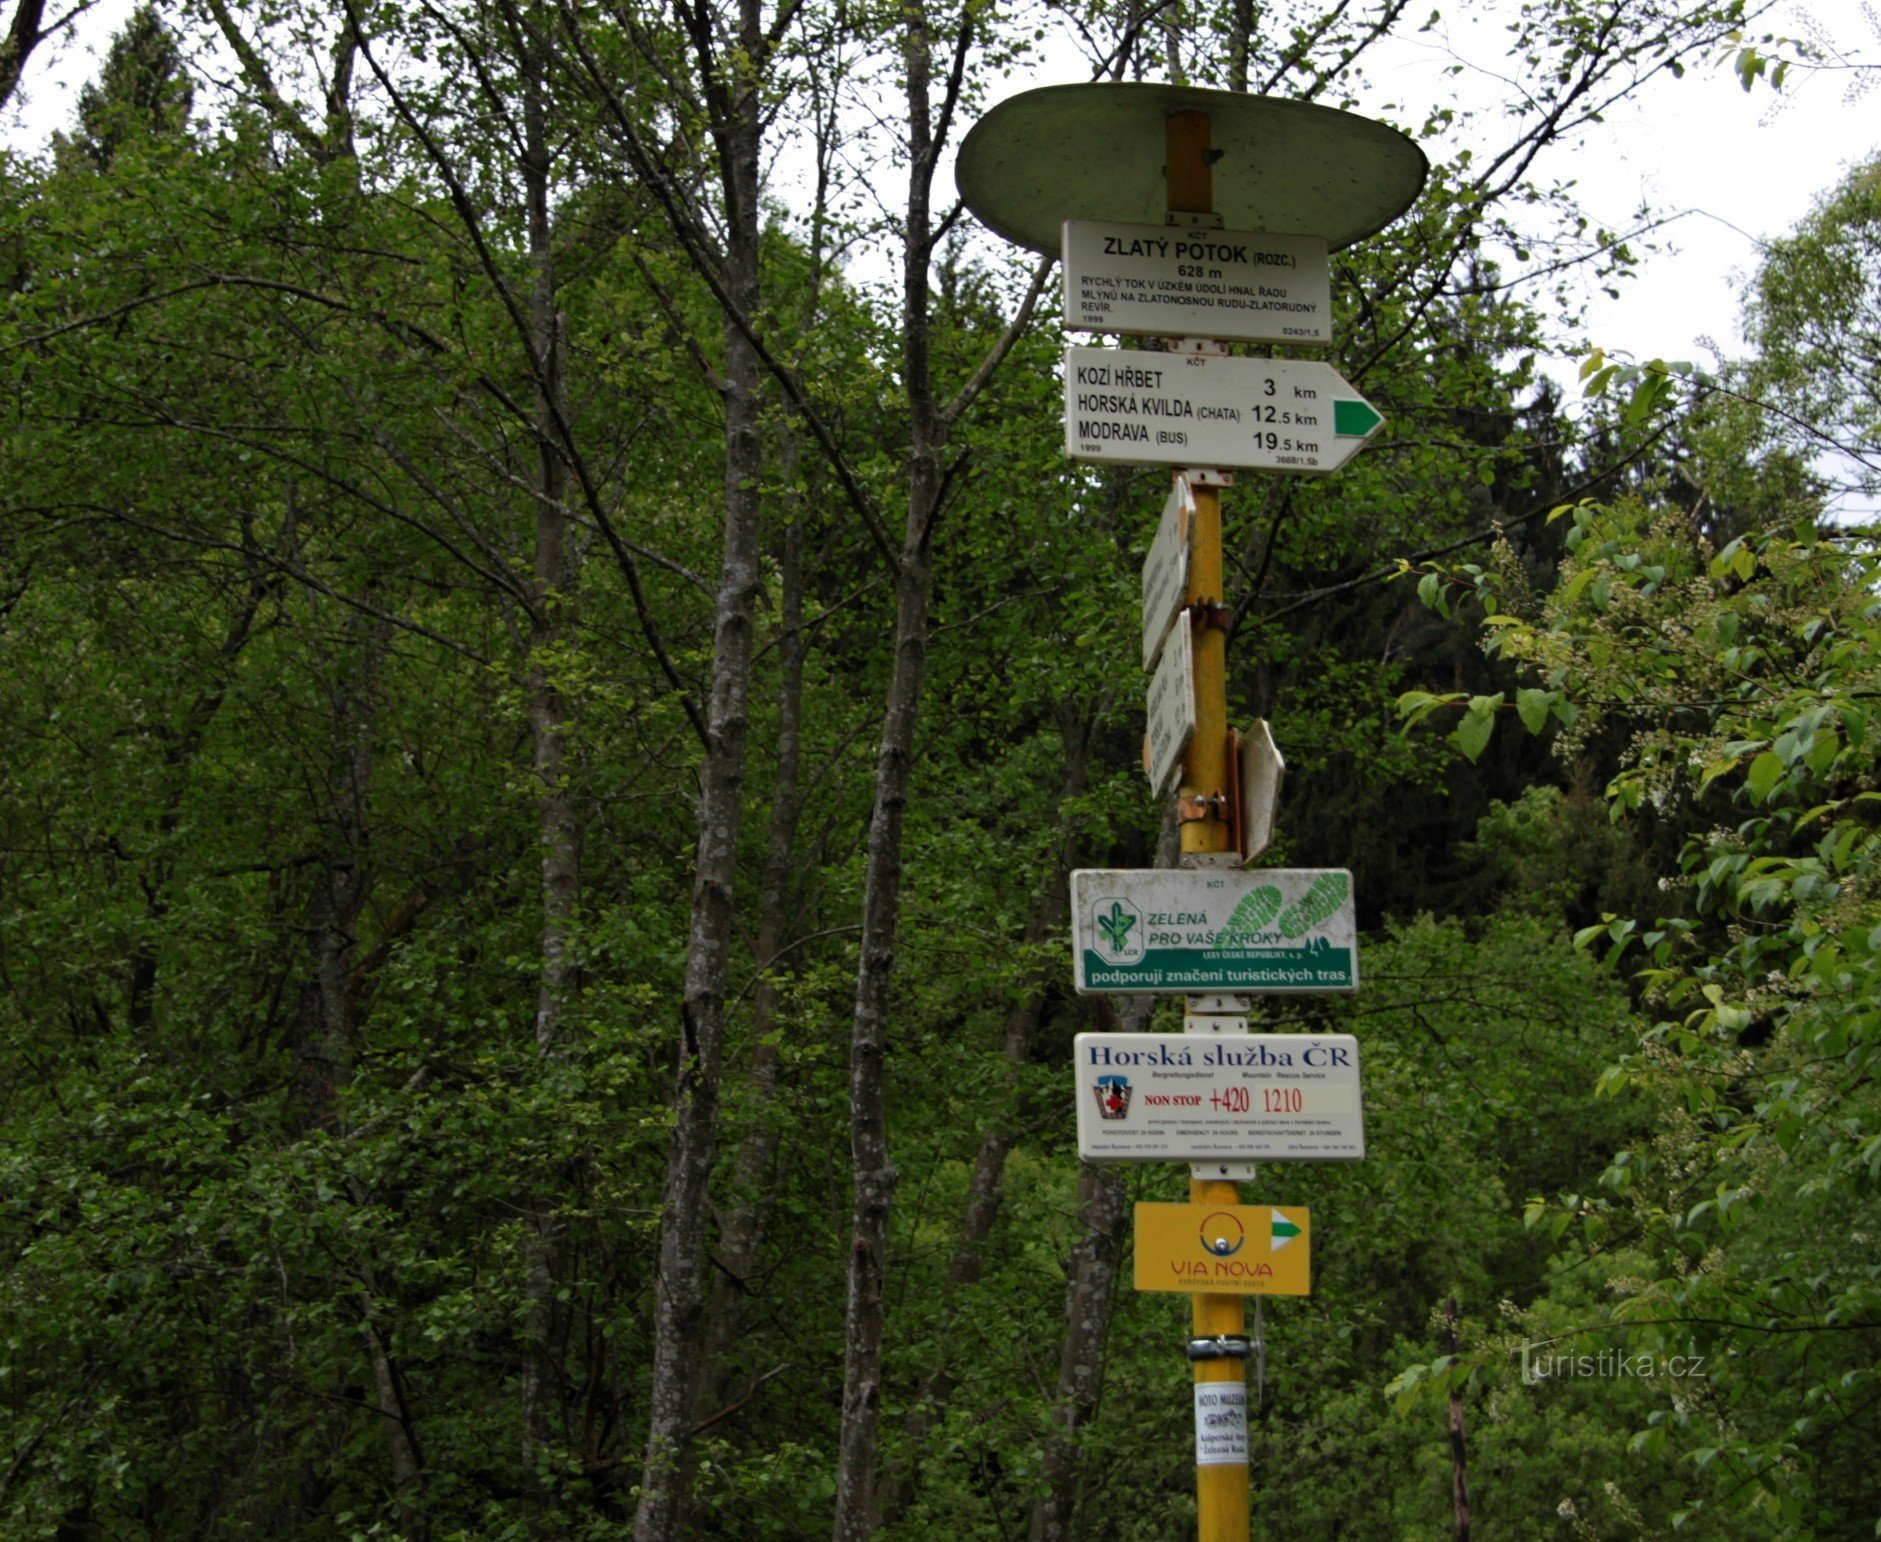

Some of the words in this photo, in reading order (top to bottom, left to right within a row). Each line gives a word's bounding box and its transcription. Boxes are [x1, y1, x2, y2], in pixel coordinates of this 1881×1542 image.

[1103, 237, 1169, 258] ZLATÝ
[1175, 242, 1248, 263] POTOK
[1253, 252, 1296, 269] (ROZC.)
[1178, 265, 1203, 277] 628
[1208, 268, 1222, 279] m
[1081, 276, 1121, 287] RYCHLÝ
[1125, 279, 1145, 288] TOK
[1148, 280, 1155, 289] V
[1229, 285, 1256, 296] HNAL
[1258, 285, 1287, 298] ŘADU
[1120, 292, 1136, 302] NA
[1138, 294, 1214, 307] ZLATONOSNOU
[1083, 315, 1104, 323] 1999
[1186, 357, 1205, 366] KČT
[1078, 365, 1111, 386] KOZÍ
[1115, 366, 1163, 389] HŘBET
[1264, 379, 1276, 396] 3
[1294, 386, 1317, 399] km
[1078, 393, 1138, 414] HORSKÁ
[1142, 397, 1193, 418] KVILDA
[1197, 406, 1241, 423] (CHATA)
[1295, 413, 1317, 426] km
[1079, 420, 1150, 442] MODRAVA
[1156, 431, 1188, 447] (BUS)
[1296, 440, 1319, 453] km
[1080, 444, 1102, 452] 1999
[1148, 911, 1208, 925] ZELENÁ
[1149, 933, 1181, 945] PRO
[1186, 931, 1224, 945] VAŠE
[1228, 932, 1283, 945] KROKY
[1092, 969, 1163, 984] podporují
[1166, 968, 1223, 982] značení
[1227, 968, 1314, 984] turistických
[1317, 970, 1346, 981] tras
[1089, 1043, 1193, 1067] Horská
[1203, 1044, 1293, 1067] služba
[1302, 1041, 1352, 1067] ČR
[1144, 1095, 1171, 1106] NON
[1173, 1095, 1202, 1106] STOP
[1209, 1086, 1250, 1113] +420
[1263, 1087, 1303, 1113] 1210
[1171, 1260, 1208, 1275] VIA
[1215, 1261, 1273, 1277] NOVA
